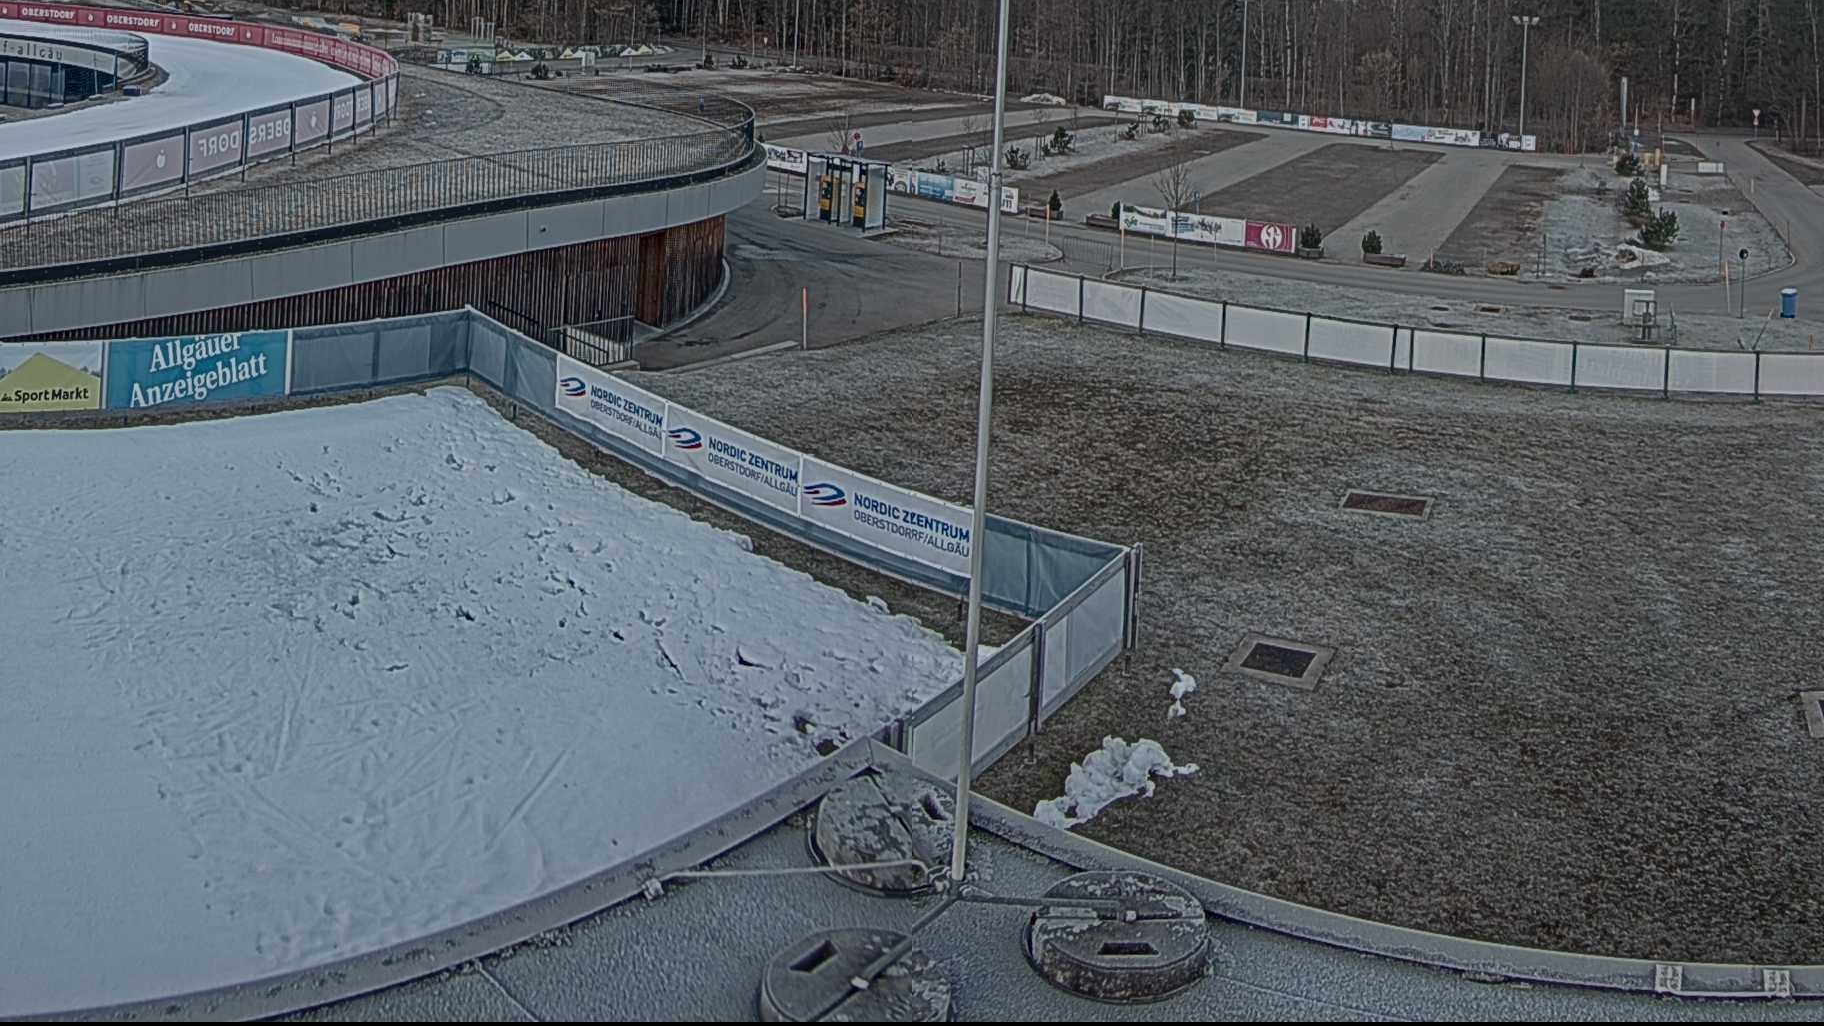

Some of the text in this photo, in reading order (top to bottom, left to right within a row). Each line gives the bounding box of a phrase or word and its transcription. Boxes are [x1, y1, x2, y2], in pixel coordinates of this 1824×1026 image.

[22, 7, 75, 20] OBERSTDORF
[106, 14, 160, 27] OBERSTDORF
[188, 24, 236, 36] OBERSTDORF
[149, 333, 243, 373] Allgäuer
[129, 352, 268, 408] Anzeigeblatt
[14, 386, 90, 404] Sport Markt
[590, 385, 664, 427] NORDIC ZENTRUM
[708, 436, 799, 484] NORDIC ZENTRUM
[853, 492, 900, 519] NORDIC
